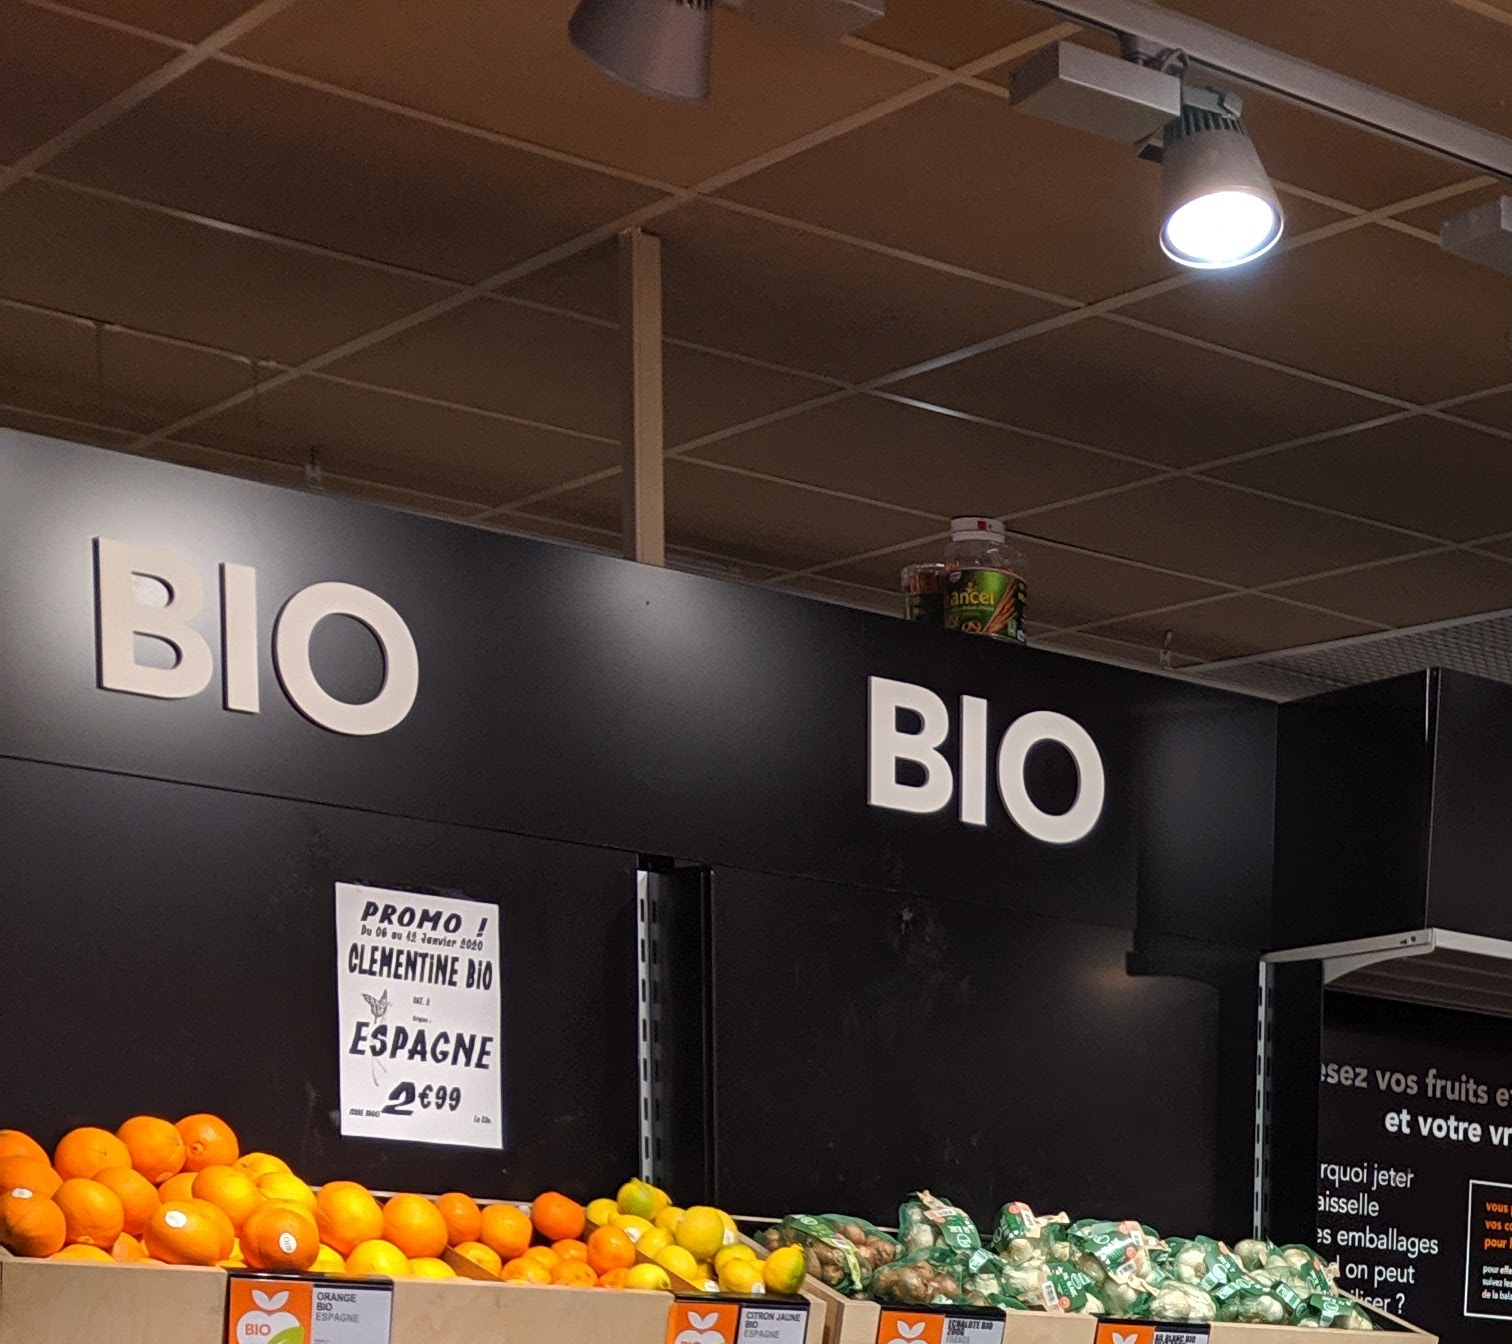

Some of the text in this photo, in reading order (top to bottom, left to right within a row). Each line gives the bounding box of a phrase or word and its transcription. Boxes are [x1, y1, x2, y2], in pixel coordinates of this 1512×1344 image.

[93, 537, 418, 736] BIO
[866, 676, 1105, 844] BIO
[361, 901, 462, 933] PROMO
[361, 924, 371, 936] Du
[376, 927, 387, 938] 06
[392, 932, 402, 940] au
[421, 932, 456, 948] Janvier
[460, 938, 483, 951] 2020
[349, 1021, 493, 1069] ESPAGNE
[1376, 1070, 1418, 1095] vos
[1426, 1068, 1488, 1104] fruits
[1385, 1108, 1410, 1134] et
[1417, 1115, 1482, 1142] votre
[1372, 1164, 1414, 1190] jeter
[1486, 1202, 1508, 1213] vous
[1485, 1220, 1501, 1230] vos
[1337, 1225, 1439, 1258] emballages
[1484, 1237, 1507, 1250] pour
[1345, 1263, 1415, 1288] on peut
[316, 1302, 332, 1311] BIO
[317, 1292, 356, 1303] ORANGE
[315, 1313, 359, 1323] ESPAGNE
[746, 1311, 774, 1320] CITRON
[245, 1324, 271, 1336] BIO
[744, 1329, 779, 1339] ESPAGNE
